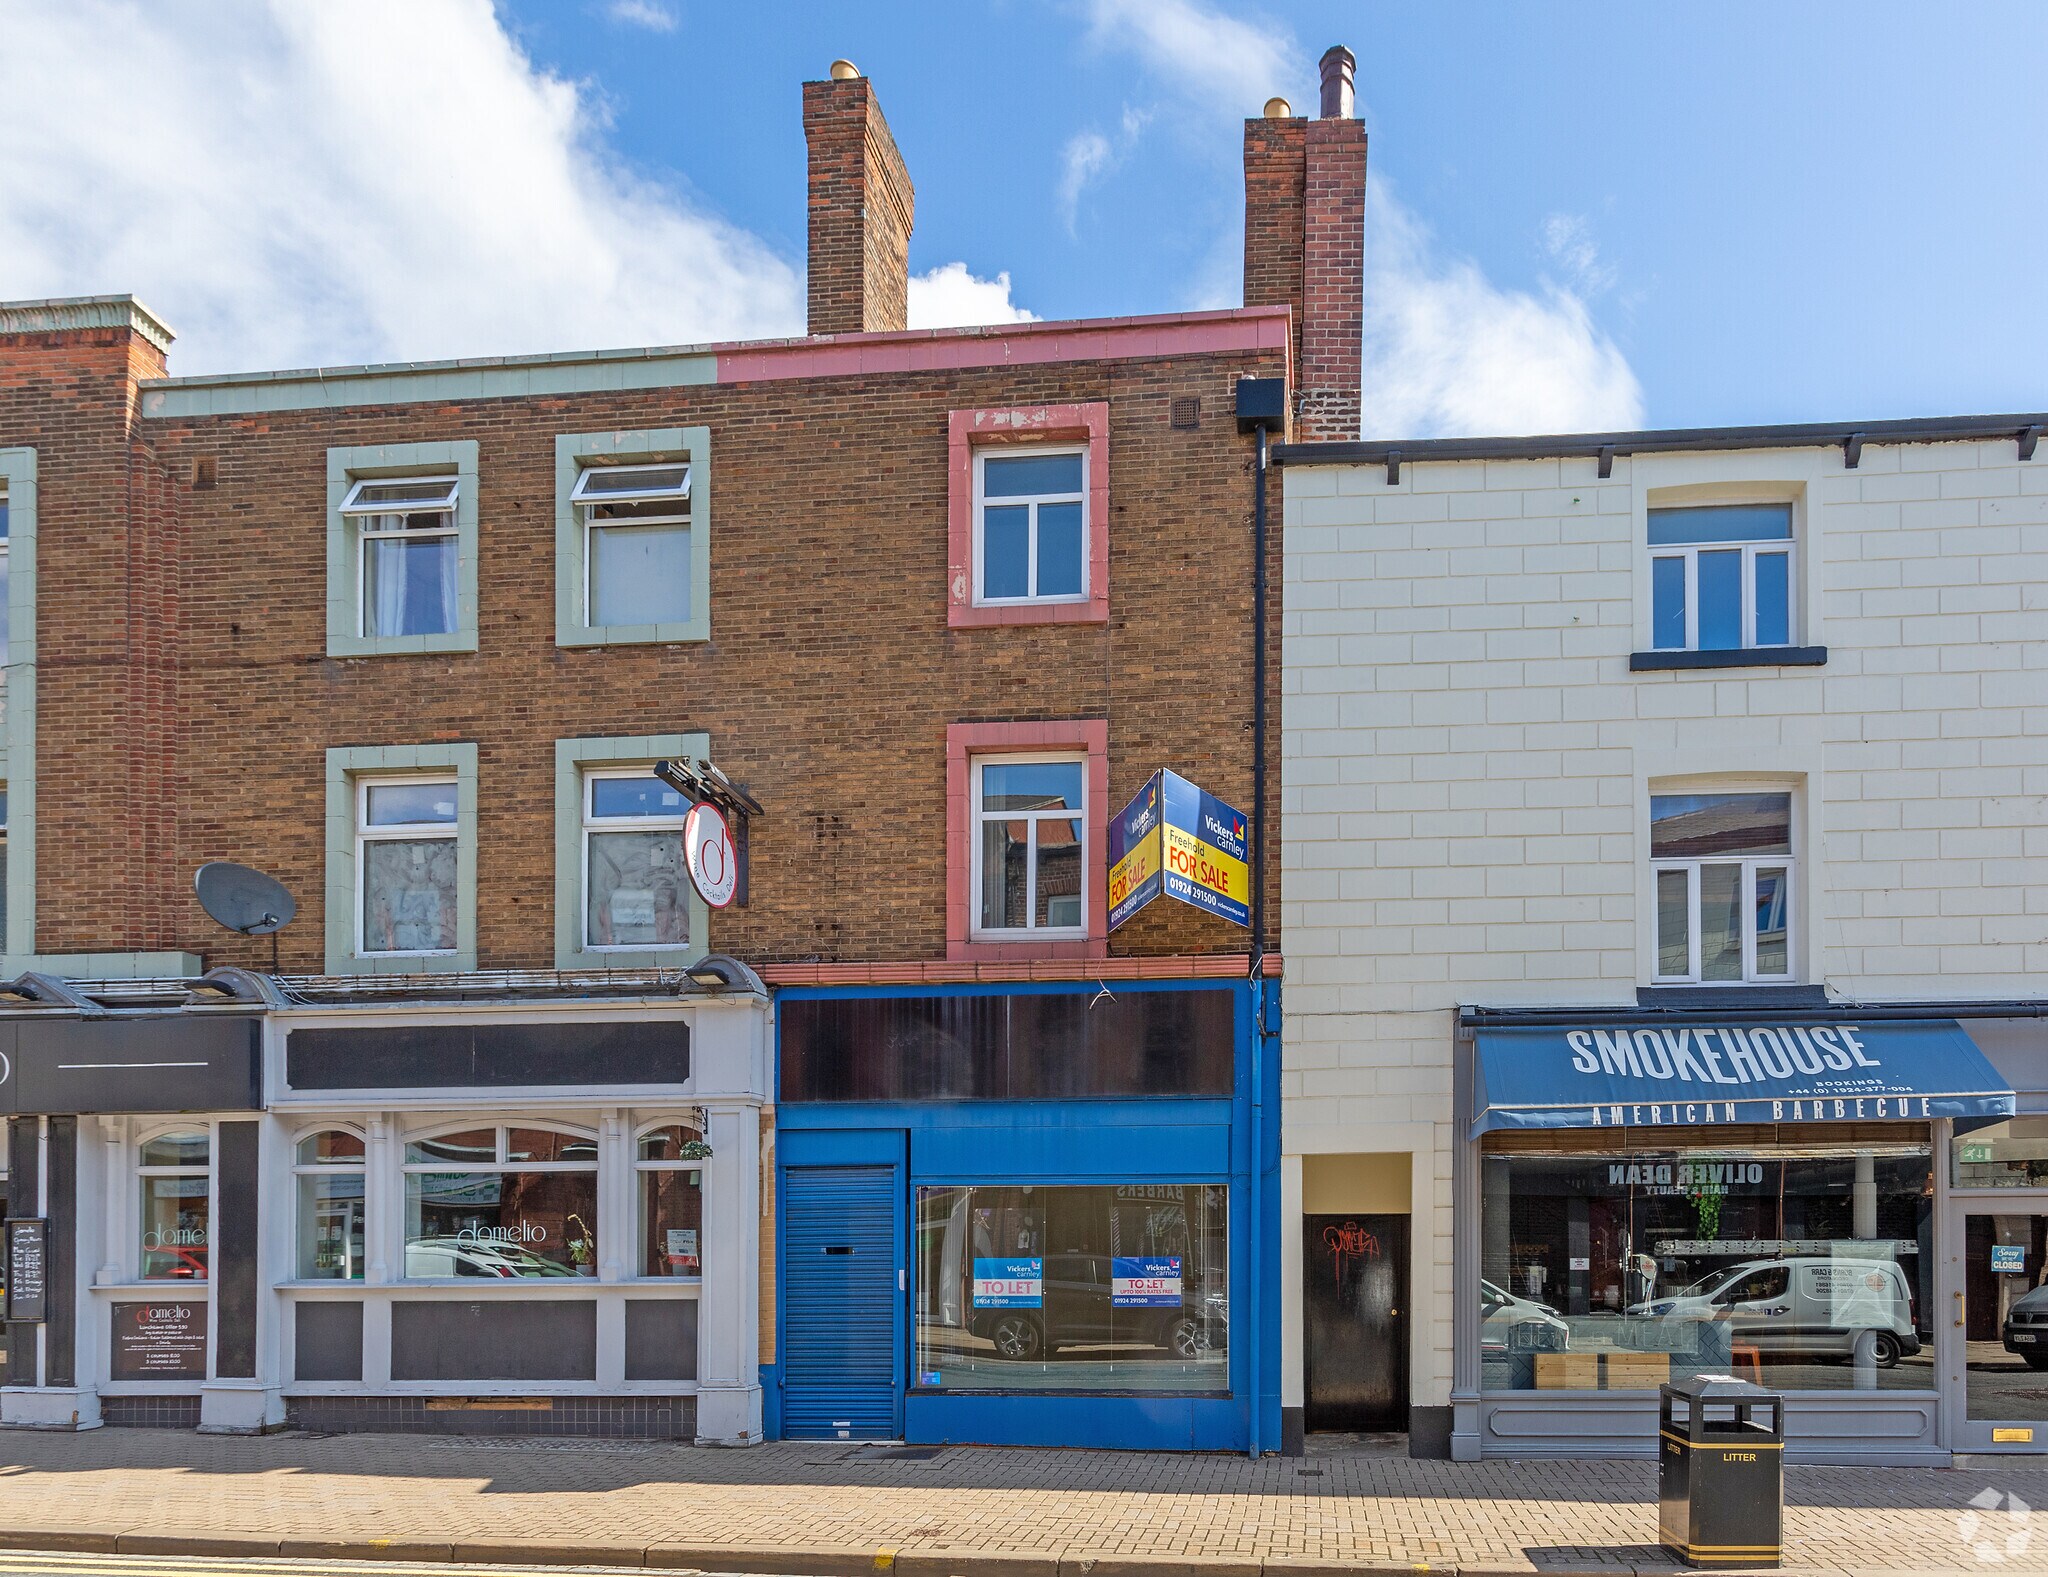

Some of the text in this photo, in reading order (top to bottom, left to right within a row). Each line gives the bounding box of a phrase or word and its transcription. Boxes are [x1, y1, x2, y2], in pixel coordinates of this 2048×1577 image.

[1132, 808, 1148, 833] Vickers
[1205, 814, 1234, 840] Vickers
[1170, 830, 1204, 857] Freehold
[1216, 836, 1244, 860] carnley
[702, 828, 725, 885] d
[1112, 855, 1132, 882] Freehold
[1170, 846, 1229, 893] FOR SALE
[1112, 878, 1126, 906] FOR
[1128, 858, 1146, 890] SALE
[1170, 877, 1192, 896] 01924
[1192, 886, 1217, 906] 291500
[1111, 906, 1122, 922] 01924
[1566, 1025, 1881, 1084] SMOKEHOUSE
[1815, 1079, 1884, 1087] BOOKINGS
[1832, 1086, 1914, 1094] 1924-377-004
[1592, 1098, 1931, 1126] AMERICAN BARBECUE
[457, 1220, 546, 1250] damelio
[1993, 1260, 2022, 1270] CLOSED
[1997, 1248, 2020, 1260] Sorry
[1128, 1280, 1166, 1288] TO LET
[1156, 1270, 1180, 1278] carnley
[982, 1282, 1034, 1294] TO LET
[136, 1304, 190, 1324] damelio
[1667, 1442, 1681, 1456] LITTER
[1723, 1453, 1757, 1462] LITTER
